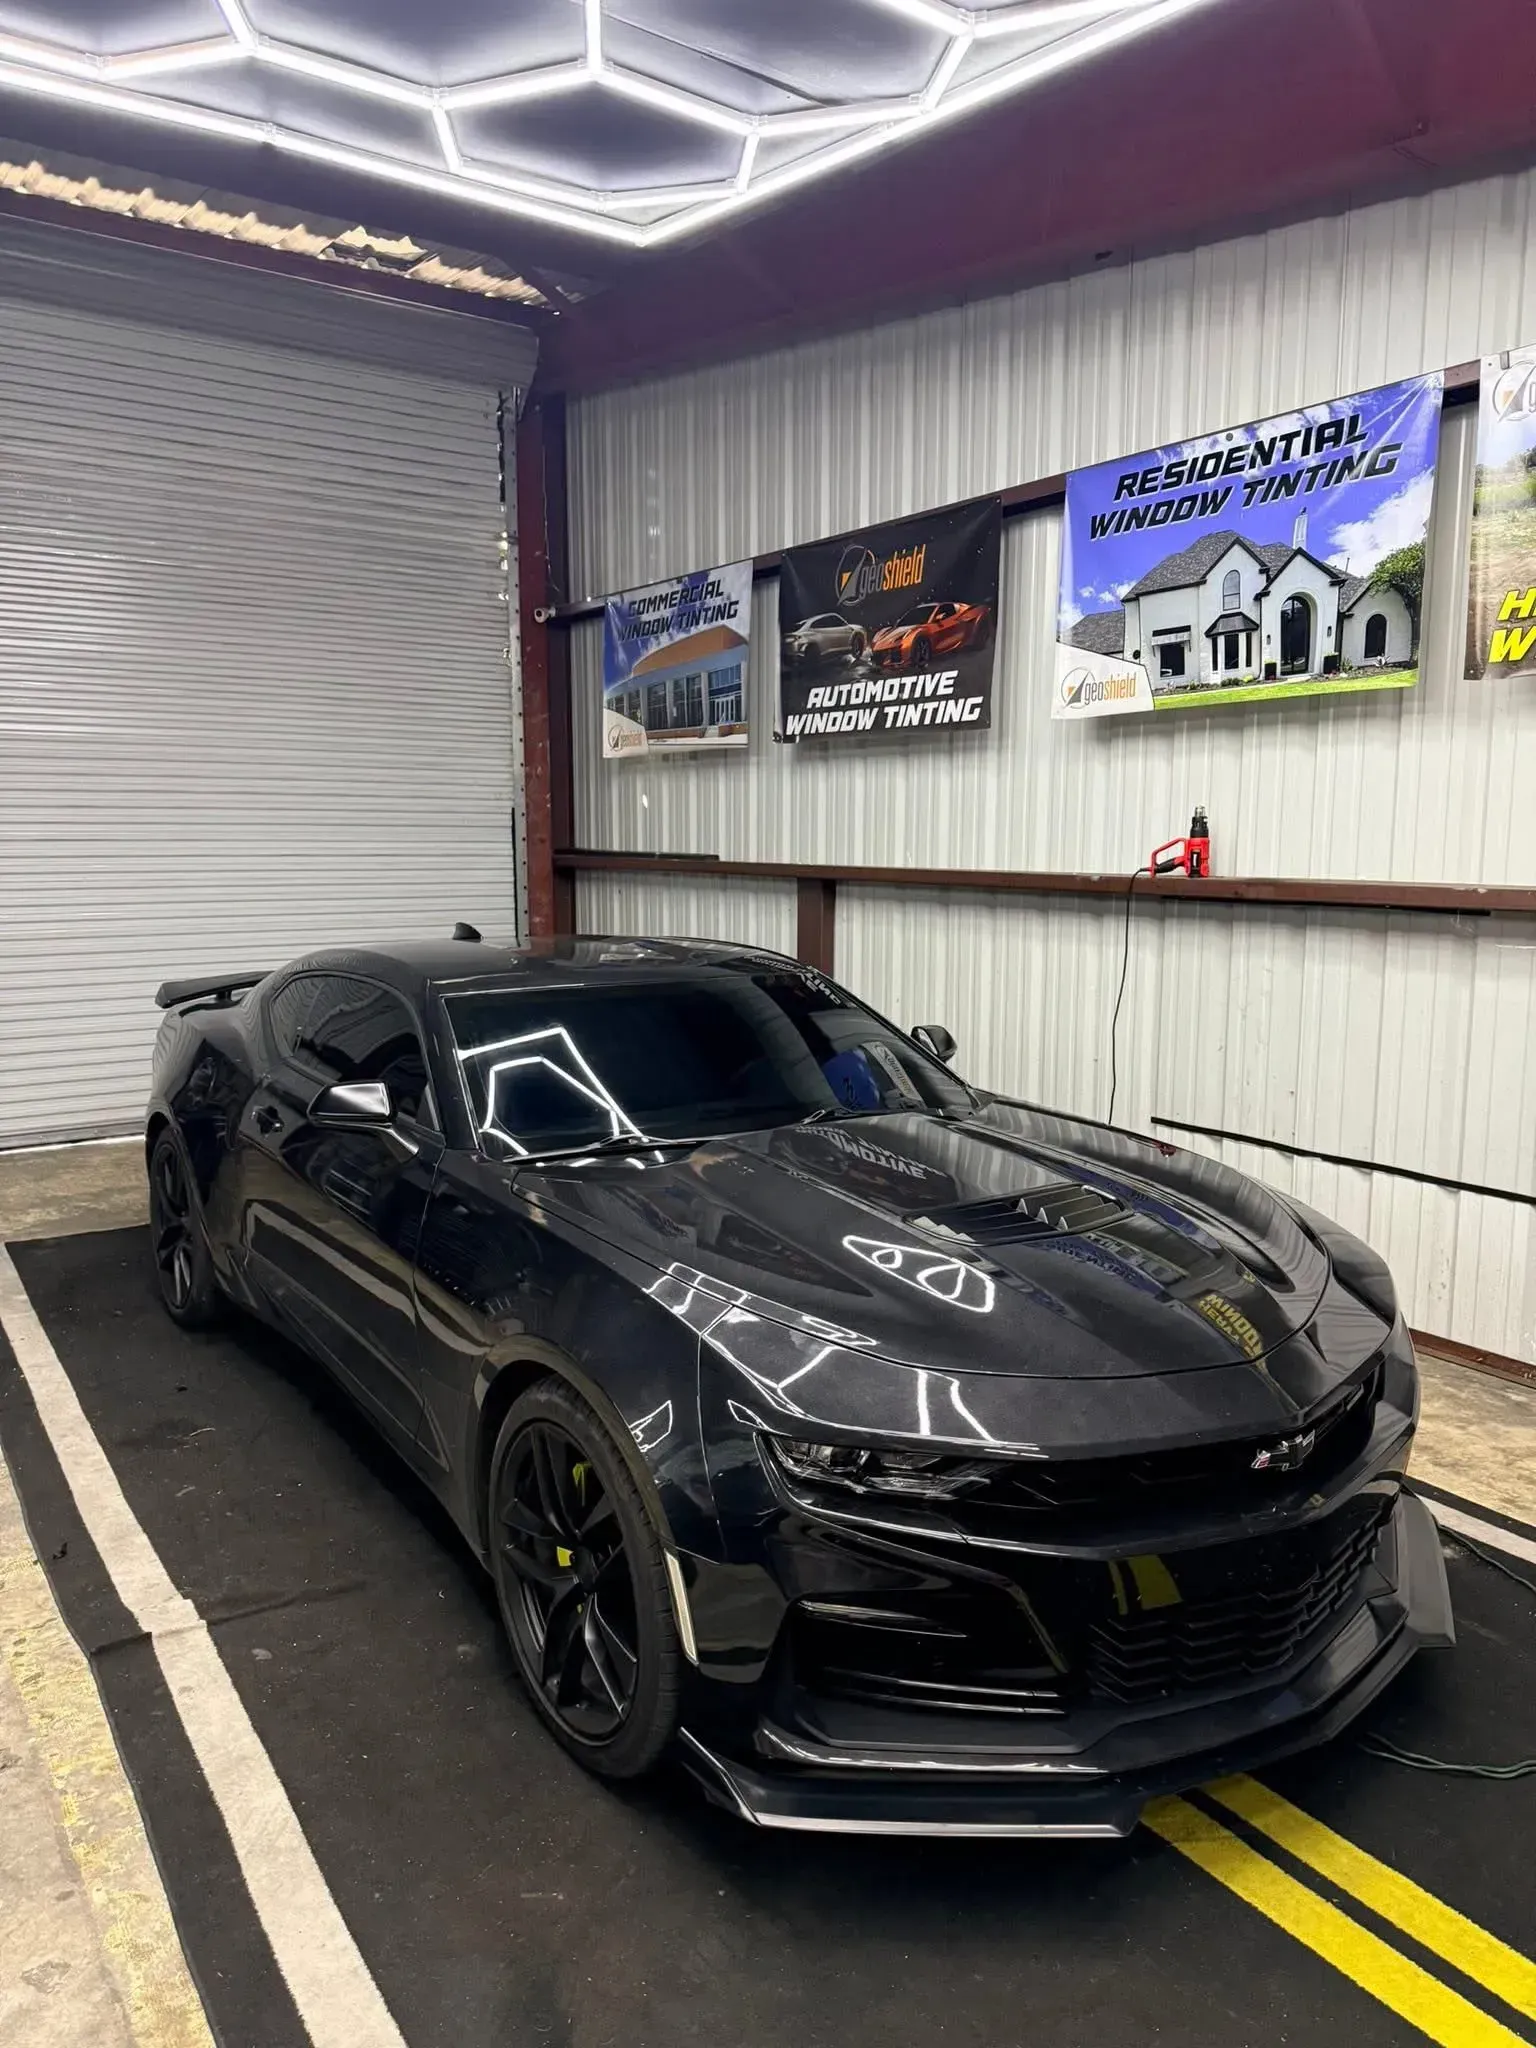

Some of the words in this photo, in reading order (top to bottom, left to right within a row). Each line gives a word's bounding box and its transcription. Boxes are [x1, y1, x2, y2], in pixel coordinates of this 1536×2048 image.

[1113, 413, 1368, 502] RESIDENTIAL
[1090, 486, 1233, 541] WINDOW
[1242, 443, 1403, 508] TINTING
[859, 543, 927, 599] geoshield
[628, 579, 725, 617] COMMERCIAL
[618, 615, 673, 642] WINDOW
[678, 600, 740, 629] TINTING
[806, 670, 959, 709] AUTOMOTIVE
[1084, 671, 1137, 704] geoshield
[786, 707, 879, 736] WINDOW
[883, 696, 984, 729] TINTING
